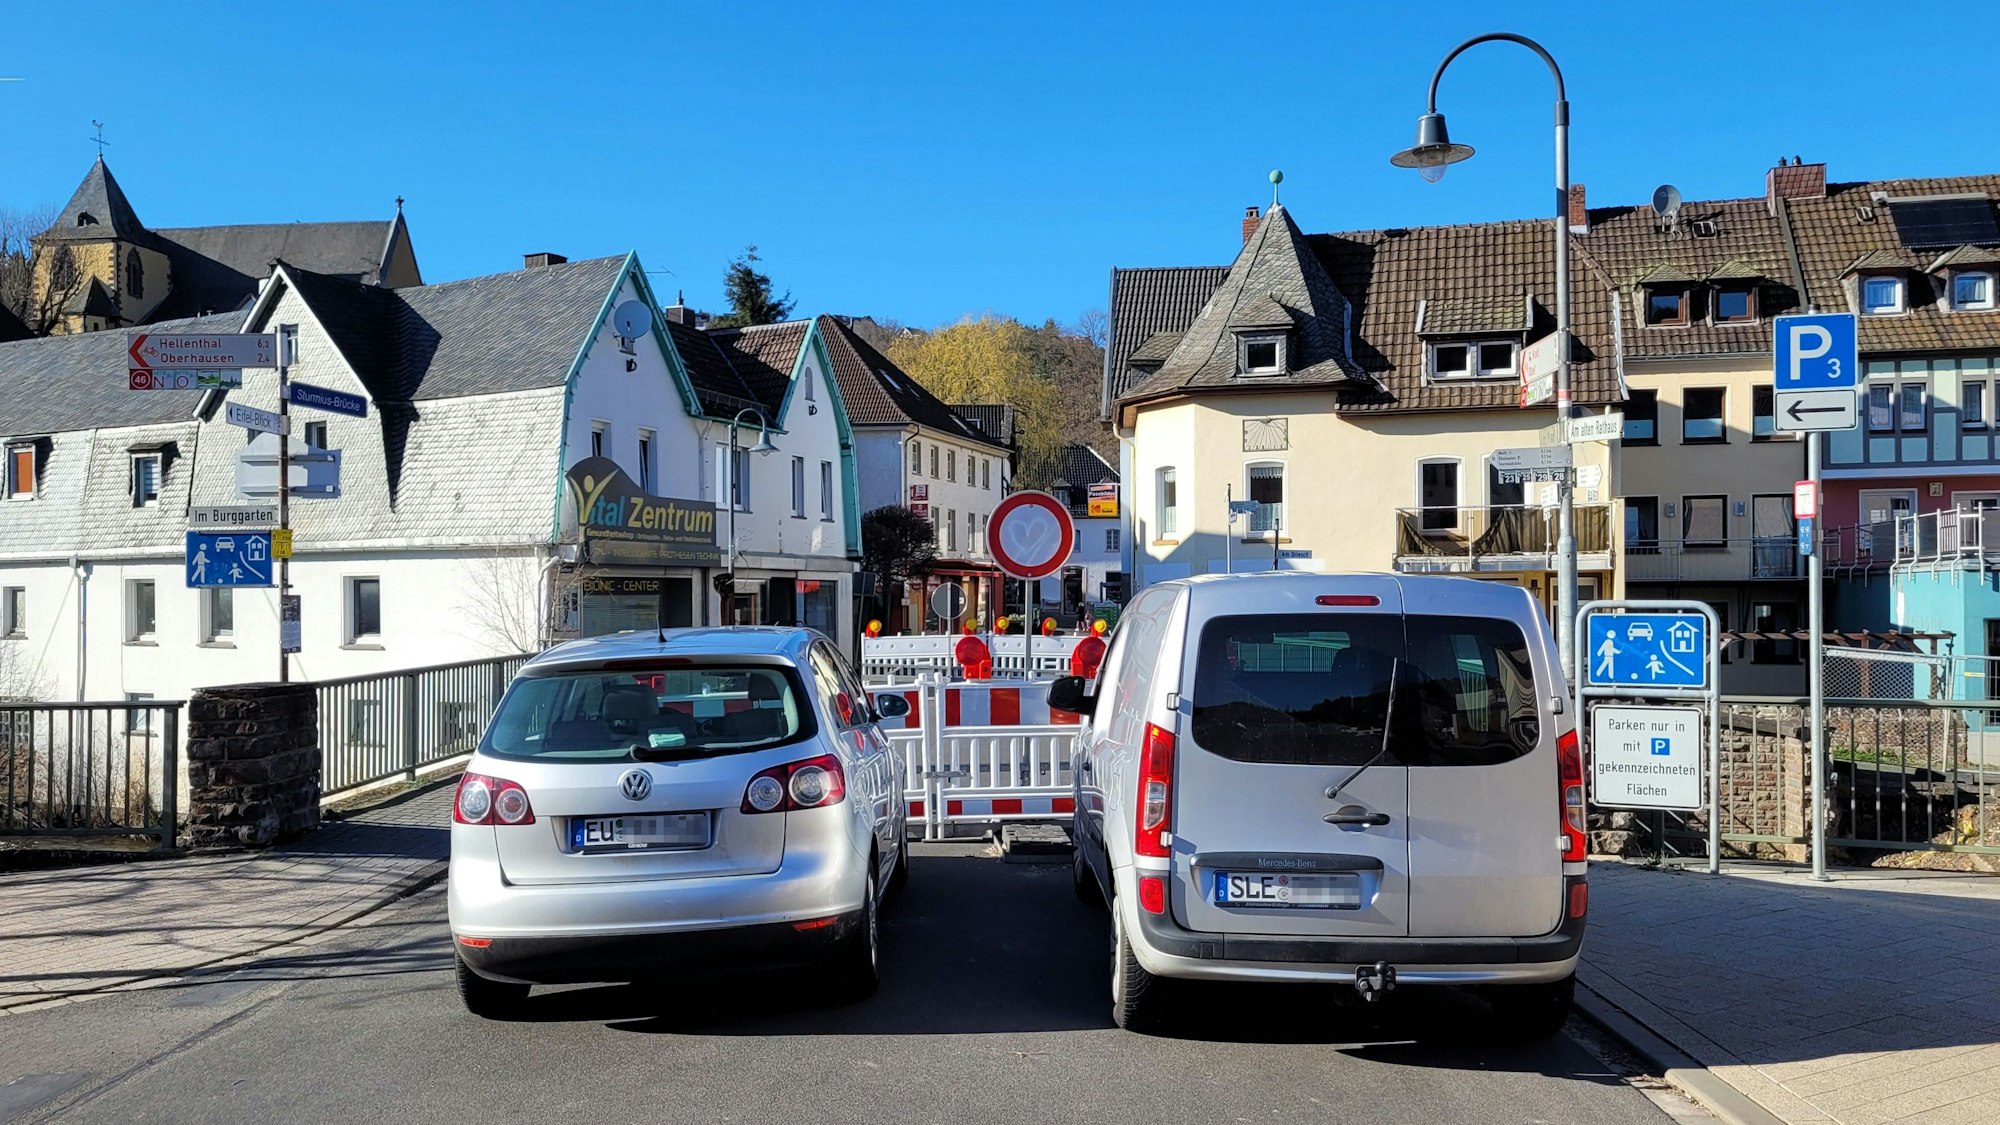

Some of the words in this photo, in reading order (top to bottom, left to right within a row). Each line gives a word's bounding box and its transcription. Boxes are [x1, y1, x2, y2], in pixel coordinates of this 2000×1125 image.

[159, 338, 222, 349] Hellenthal
[160, 353, 234, 363] Oberhausen
[257, 353, 270, 364] 2,4
[1789, 325, 1833, 381] P
[1826, 357, 1841, 379] 3
[133, 375, 147, 384] 46
[153, 376, 165, 388] N
[296, 388, 360, 412] Sturmius-Brücke
[236, 408, 271, 428] Eifel-Blick
[1571, 423, 1580, 437] Am
[1581, 422, 1594, 437] alten
[1596, 420, 1617, 434] Rathaus
[1505, 475, 1515, 483] 23
[1554, 472, 1565, 480] 28
[569, 470, 625, 527] Vital
[628, 497, 713, 532] Zentrum
[194, 510, 208, 522] Im
[212, 509, 273, 525] Burggarten
[659, 550, 696, 560] PROTHESEN
[696, 552, 720, 560] TECHNIK
[583, 581, 616, 591] BIONIC
[623, 581, 659, 592] CENTER
[1608, 718, 1646, 731] Parken
[1650, 721, 1669, 732] nur
[1675, 720, 1685, 732] in
[1623, 740, 1641, 752] mit
[1654, 739, 1666, 753] P
[1598, 761, 1696, 776] gekennzeichneten
[1626, 783, 1667, 797] Flächen
[586, 820, 614, 843] EU
[1258, 858, 1317, 868] Mercedes-Benz
[1230, 876, 1276, 899] SLE
